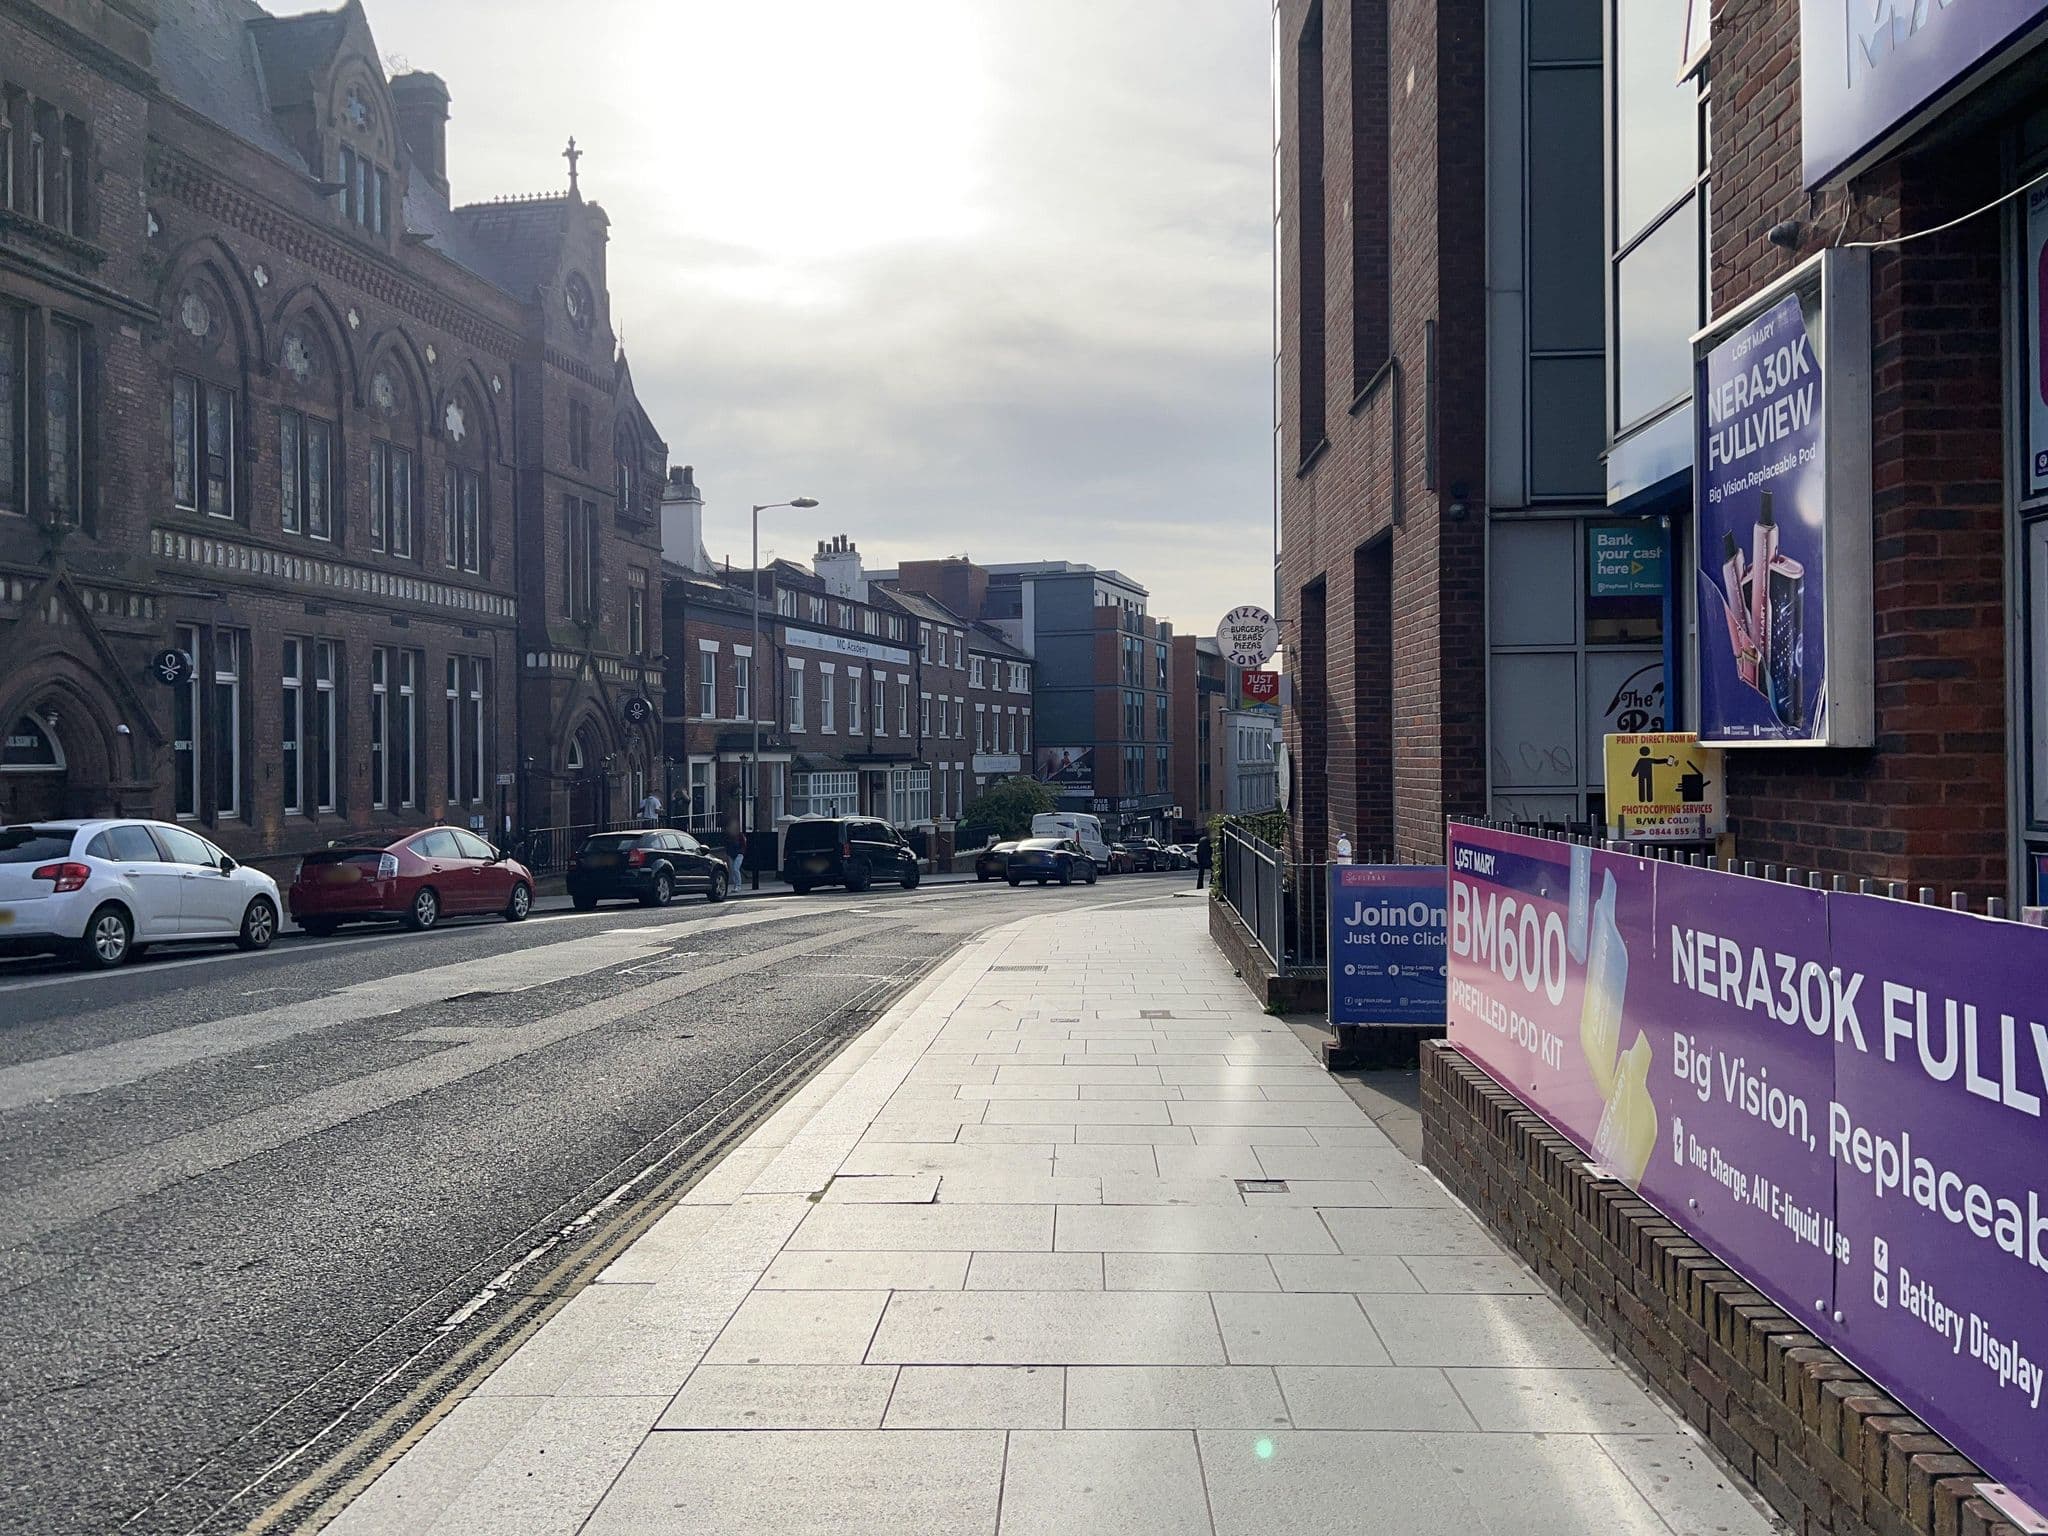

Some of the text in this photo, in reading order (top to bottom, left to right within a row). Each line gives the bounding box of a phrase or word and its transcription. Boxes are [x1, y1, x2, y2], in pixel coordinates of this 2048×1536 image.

[1732, 321, 1775, 361] LOST MARY
[1708, 333, 1810, 428] NERA30K
[1709, 382, 1814, 472] FULLVIEW
[1709, 486, 1721, 504] Big
[1799, 442, 1816, 465] Pod
[1597, 533, 1633, 546] Bank
[1597, 550, 1630, 562] your
[1597, 561, 1629, 575] here
[1227, 607, 1269, 625] PIZZA
[1228, 650, 1267, 665] ZONE
[1247, 674, 1273, 685] JUST
[1252, 684, 1273, 694] EAT
[1621, 689, 1653, 708] The
[1616, 735, 1638, 744] PRINT
[1640, 735, 1664, 744] DIRECT
[1666, 735, 1685, 744] FROM
[1621, 804, 1712, 814] PHOTOCOPYING SERVICES
[1636, 817, 1657, 825] B/W
[1658, 817, 1665, 825] &
[1649, 828, 1671, 836] 0844
[1454, 846, 1495, 876] LOST MARY
[1344, 931, 1376, 945] Just
[1380, 931, 1409, 945] One
[1452, 880, 1566, 1007] BM600
[1671, 924, 1868, 1053] NERA30K
[1452, 977, 1563, 1071] PREFILLED POD KIT
[1673, 1031, 1711, 1102] Big
[1719, 1051, 1816, 1153] Vision,
[1689, 1133, 1850, 1265] One Charge, All E-liquid Use
[1900, 1267, 2043, 1409] Battery Display
